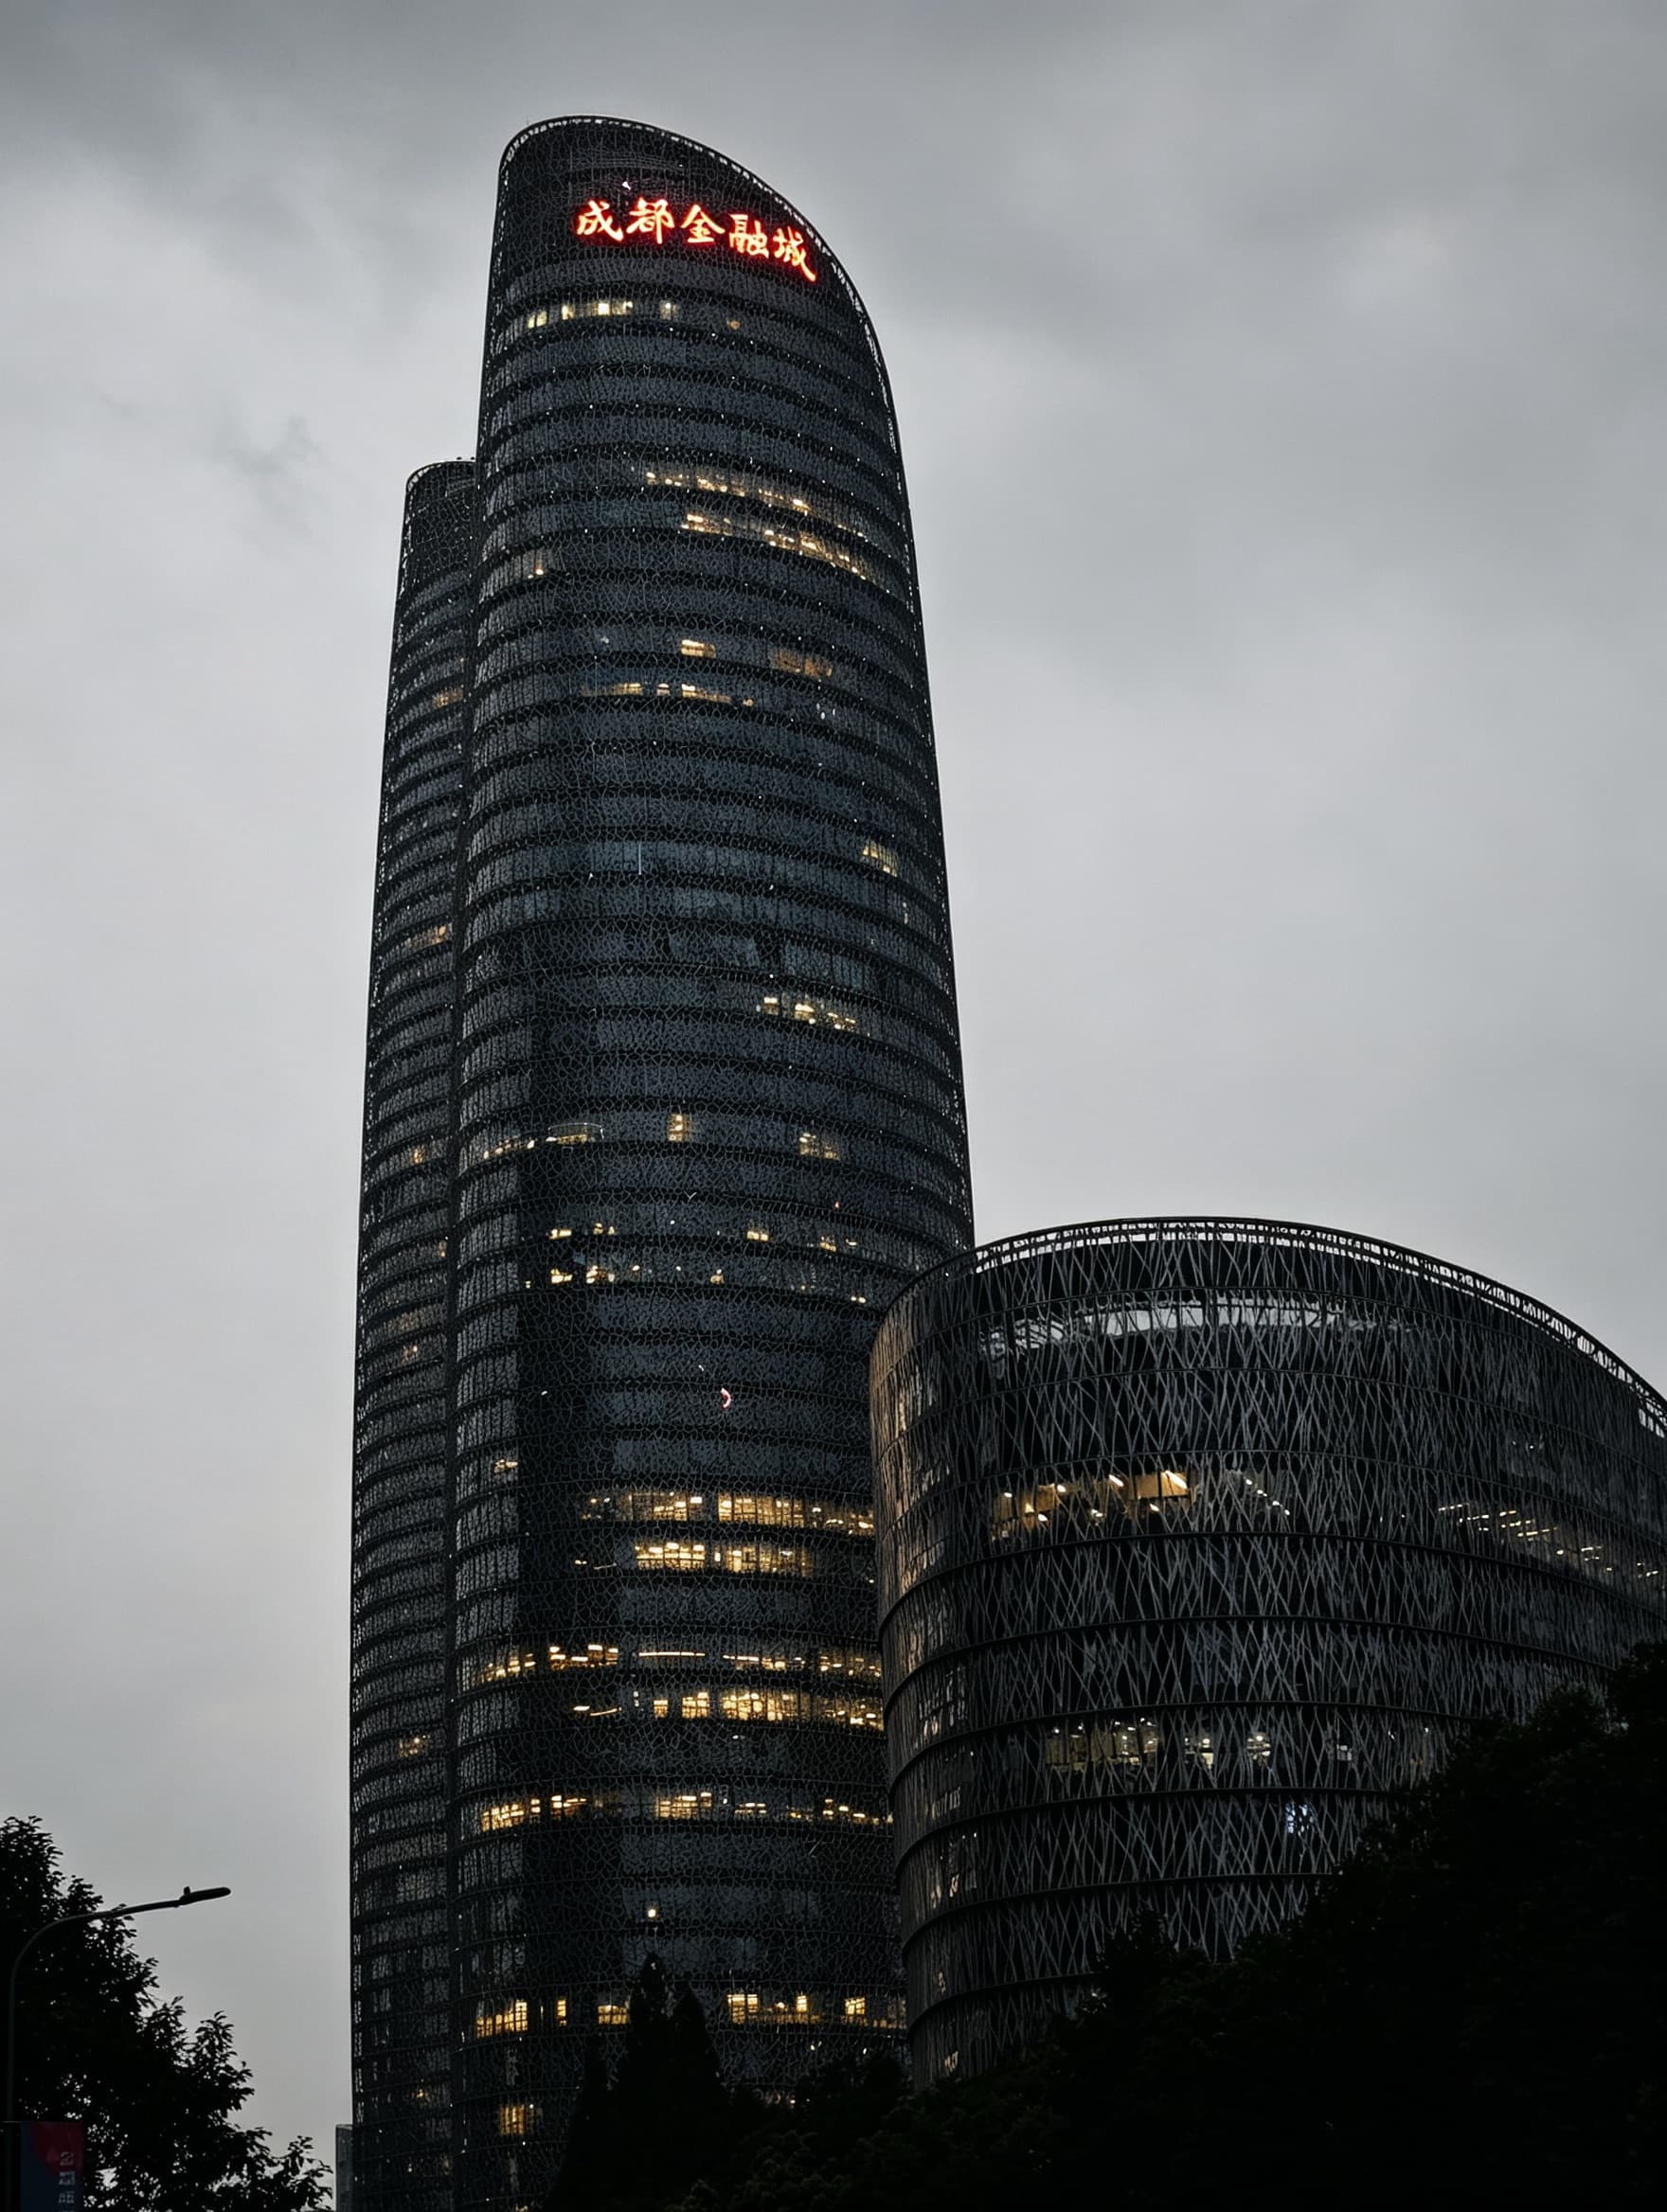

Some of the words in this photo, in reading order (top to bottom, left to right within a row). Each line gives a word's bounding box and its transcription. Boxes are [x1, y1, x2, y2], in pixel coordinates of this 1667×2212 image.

[575, 196, 816, 282] 成都金融城
